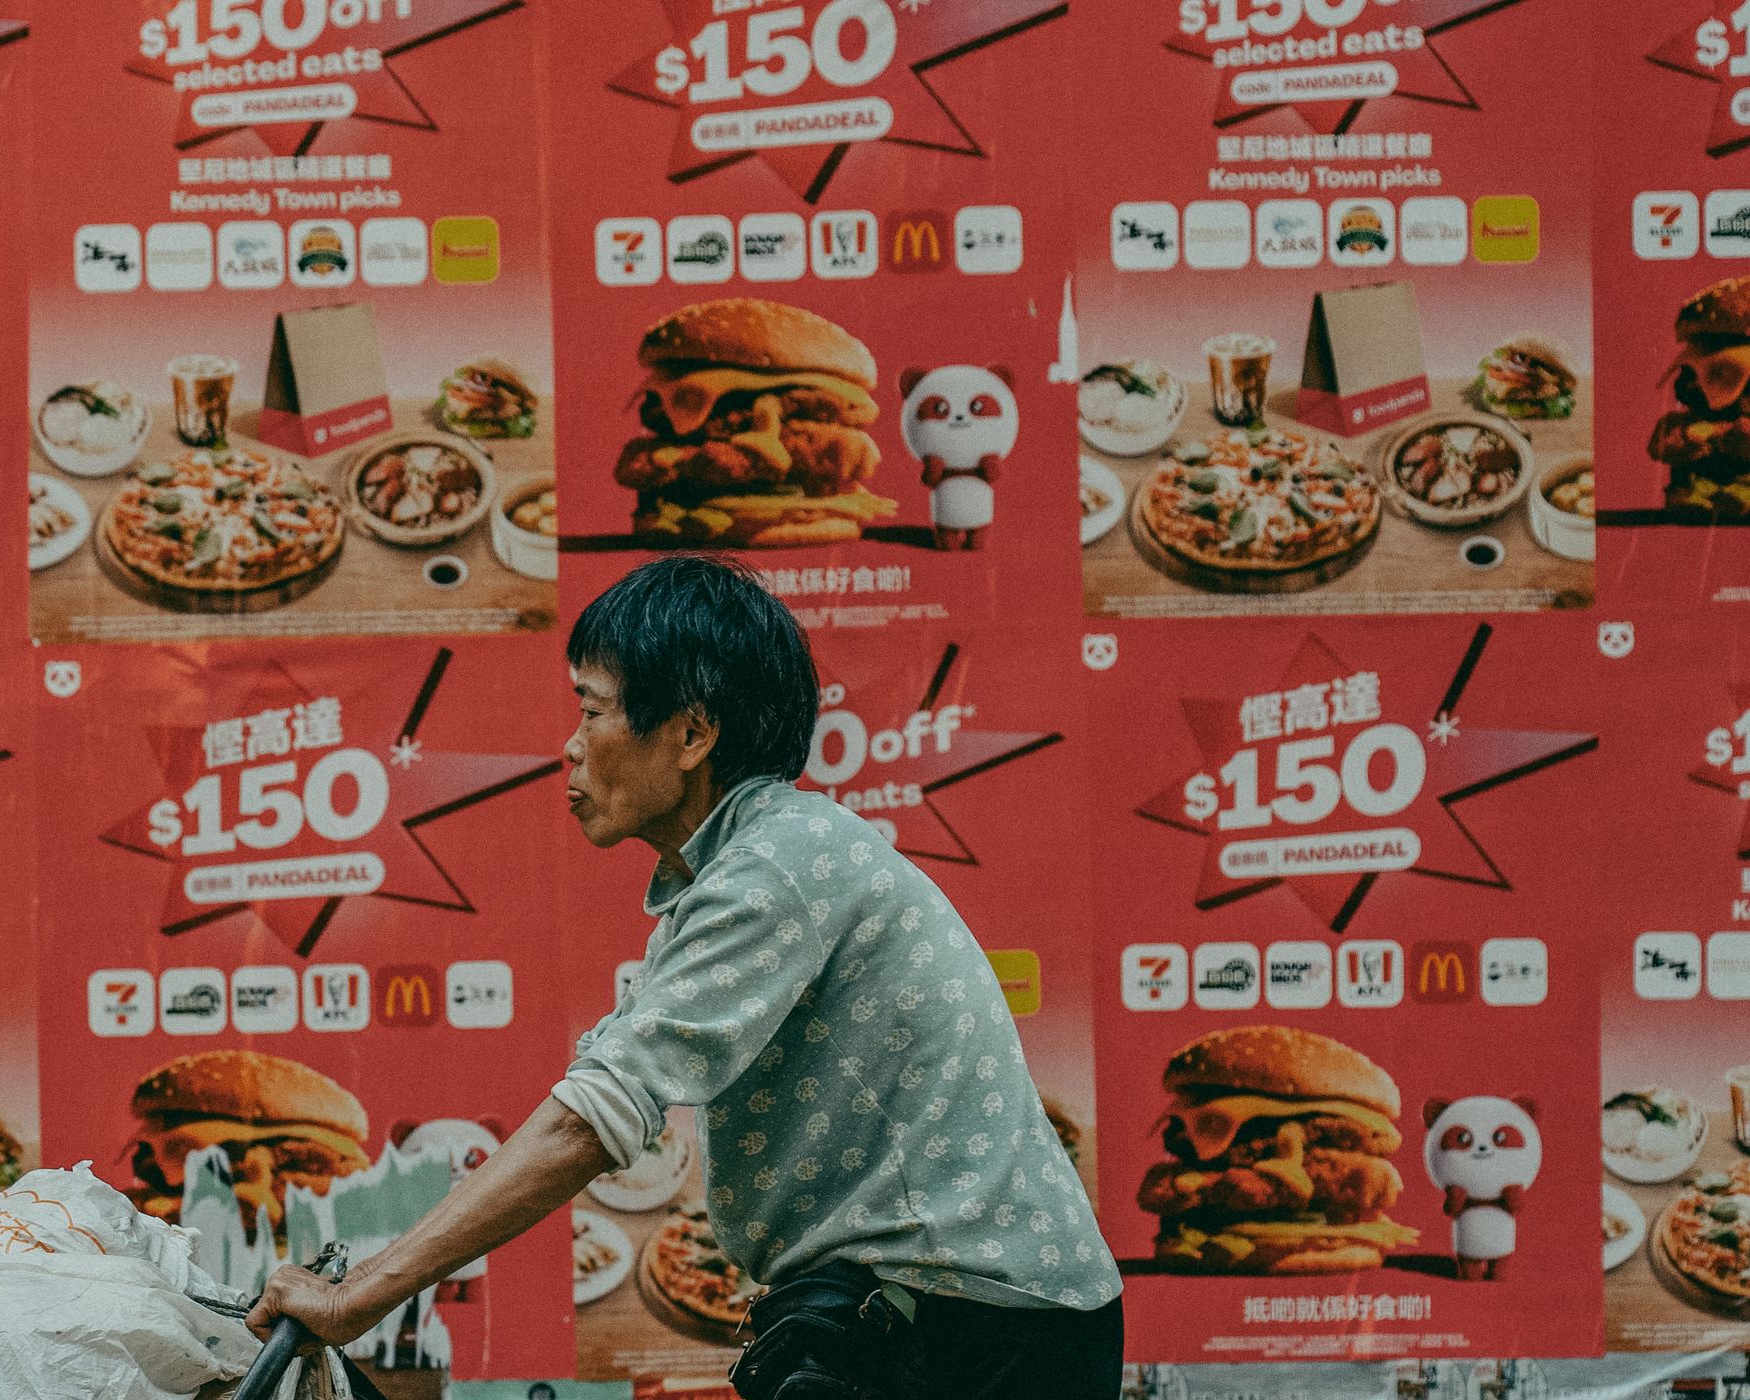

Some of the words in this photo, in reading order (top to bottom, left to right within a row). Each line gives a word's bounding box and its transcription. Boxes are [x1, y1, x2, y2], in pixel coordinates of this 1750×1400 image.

[656, 0, 898, 103] $150
[1213, 36, 1337, 68] selected
[1344, 26, 1425, 55] eats
[174, 52, 296, 91] selected
[302, 46, 382, 77] eats
[1282, 72, 1386, 92] PANDADEAL
[754, 109, 879, 135] PANDADEAL
[1209, 168, 1310, 192] Kennedy
[1314, 167, 1376, 189] Town
[1381, 165, 1441, 190] picks
[171, 190, 270, 213] Kennedy
[276, 188, 336, 208] Town
[341, 187, 401, 211] picks
[1240, 672, 1381, 743] 慳高達
[202, 696, 344, 769] 慳高達
[1185, 724, 1426, 831] $150
[149, 748, 389, 855] $150
[843, 781, 922, 811] eats
[1283, 838, 1407, 865] PANDADEAL
[247, 865, 371, 890] PANDADEAL
